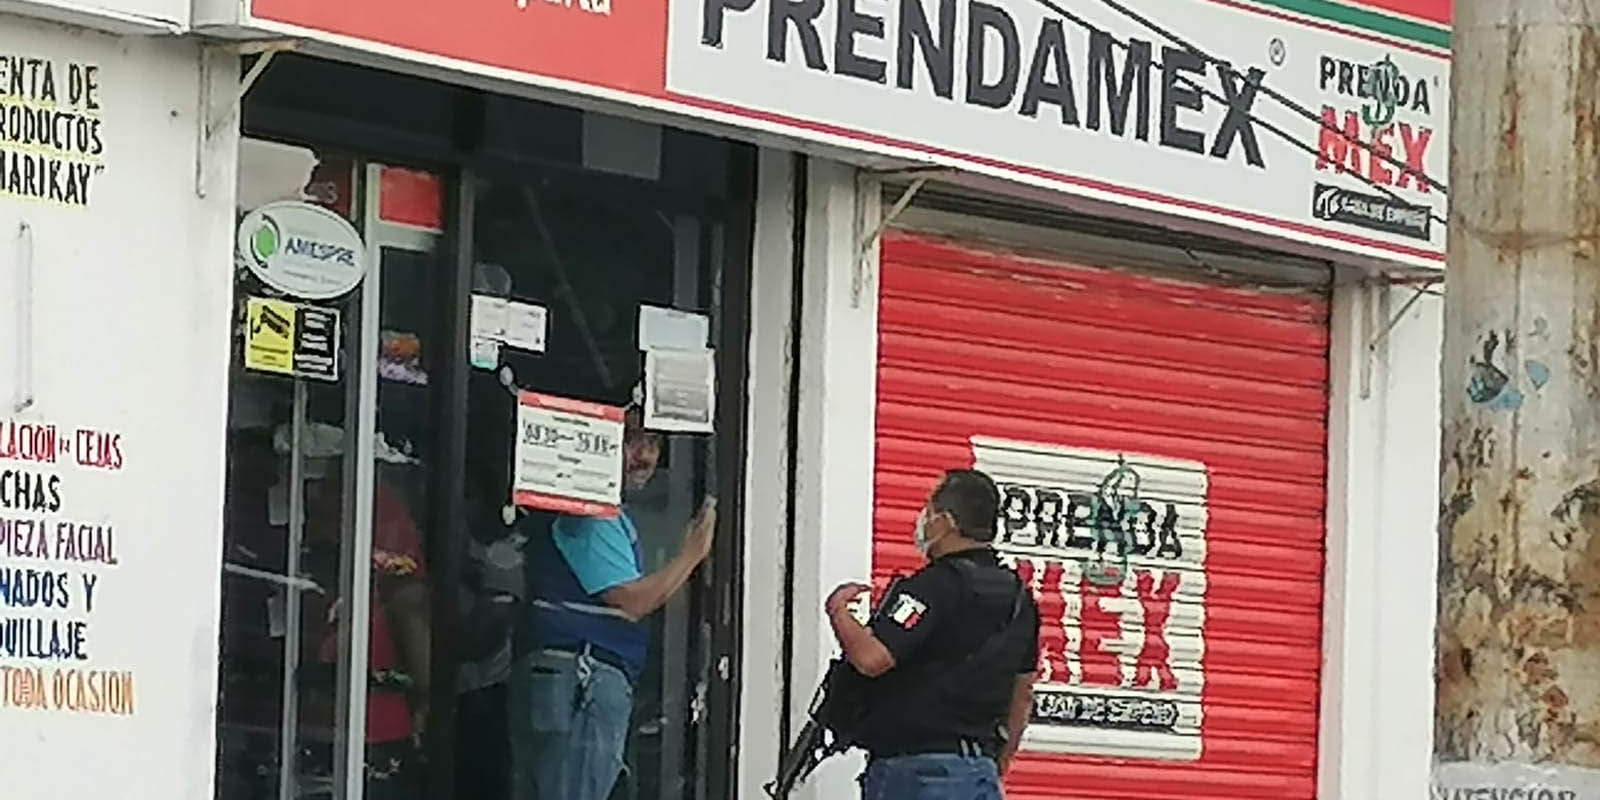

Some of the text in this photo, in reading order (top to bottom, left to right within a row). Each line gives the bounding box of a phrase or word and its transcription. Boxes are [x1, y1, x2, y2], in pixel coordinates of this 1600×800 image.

[69, 63, 99, 109] DE
[1315, 104, 1433, 193] MEX
[76, 429, 123, 470] CEJAS
[56, 522, 118, 565] FACIAL
[1003, 486, 1182, 561] PRENDA
[82, 574, 97, 612] Y
[53, 668, 134, 715] OCASION
